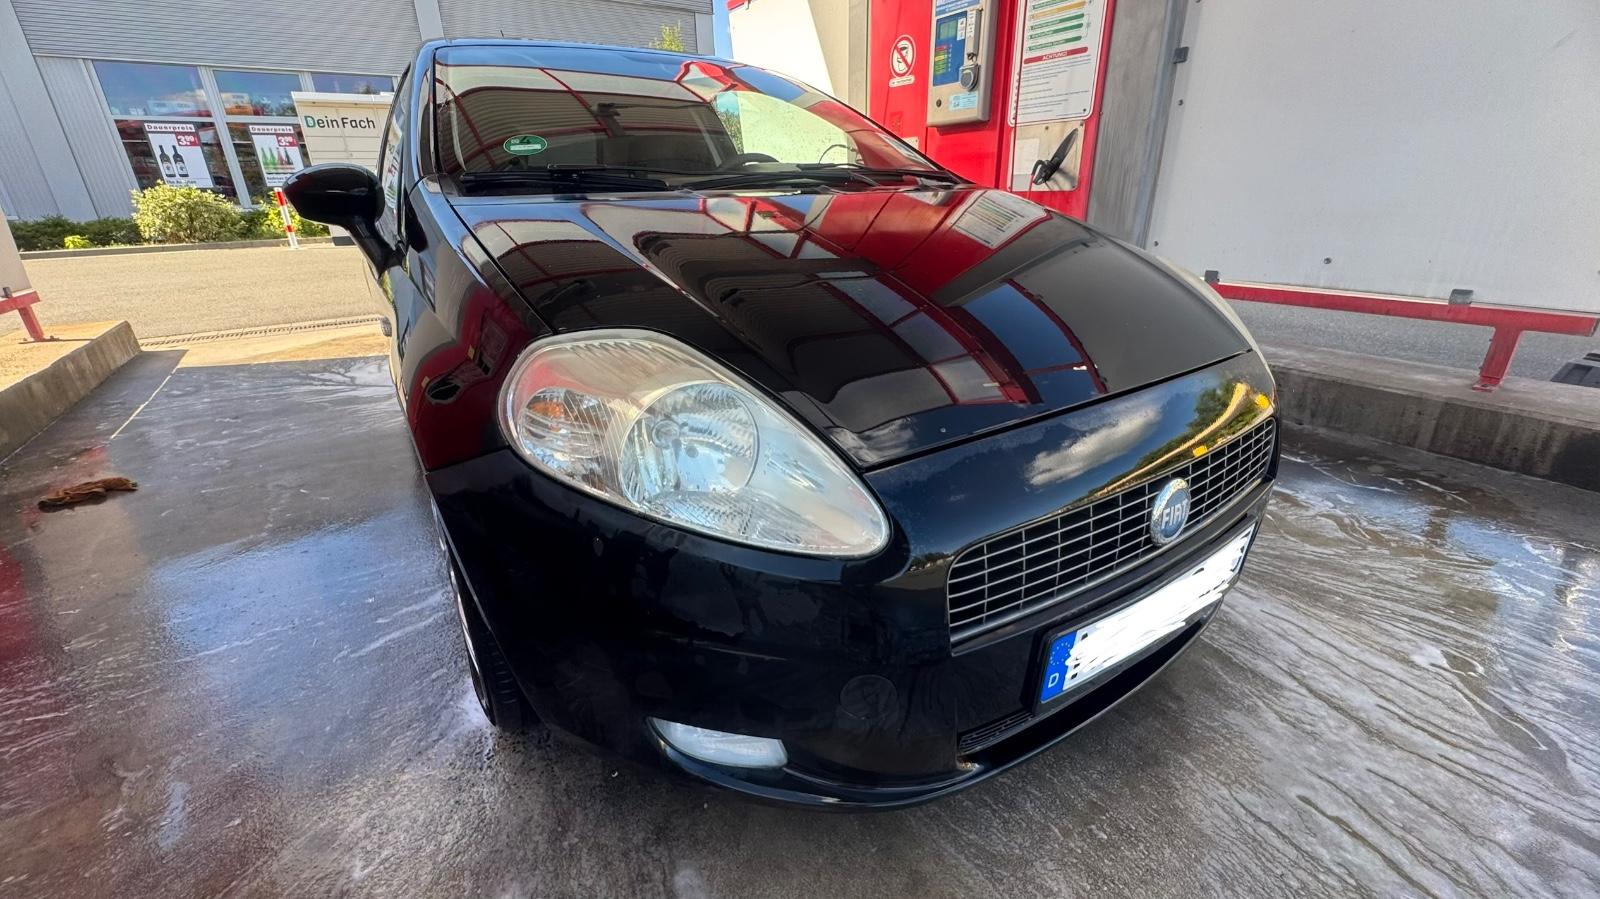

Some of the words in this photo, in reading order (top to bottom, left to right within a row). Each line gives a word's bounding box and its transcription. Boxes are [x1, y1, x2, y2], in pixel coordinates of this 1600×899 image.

[1042, 52, 1068, 61] ACHTUNG!
[147, 124, 193, 132] Dauerpreis
[305, 115, 339, 129] Dein
[341, 117, 376, 129] Fach
[1161, 498, 1188, 530] FIAT
[1047, 672, 1060, 688] D
